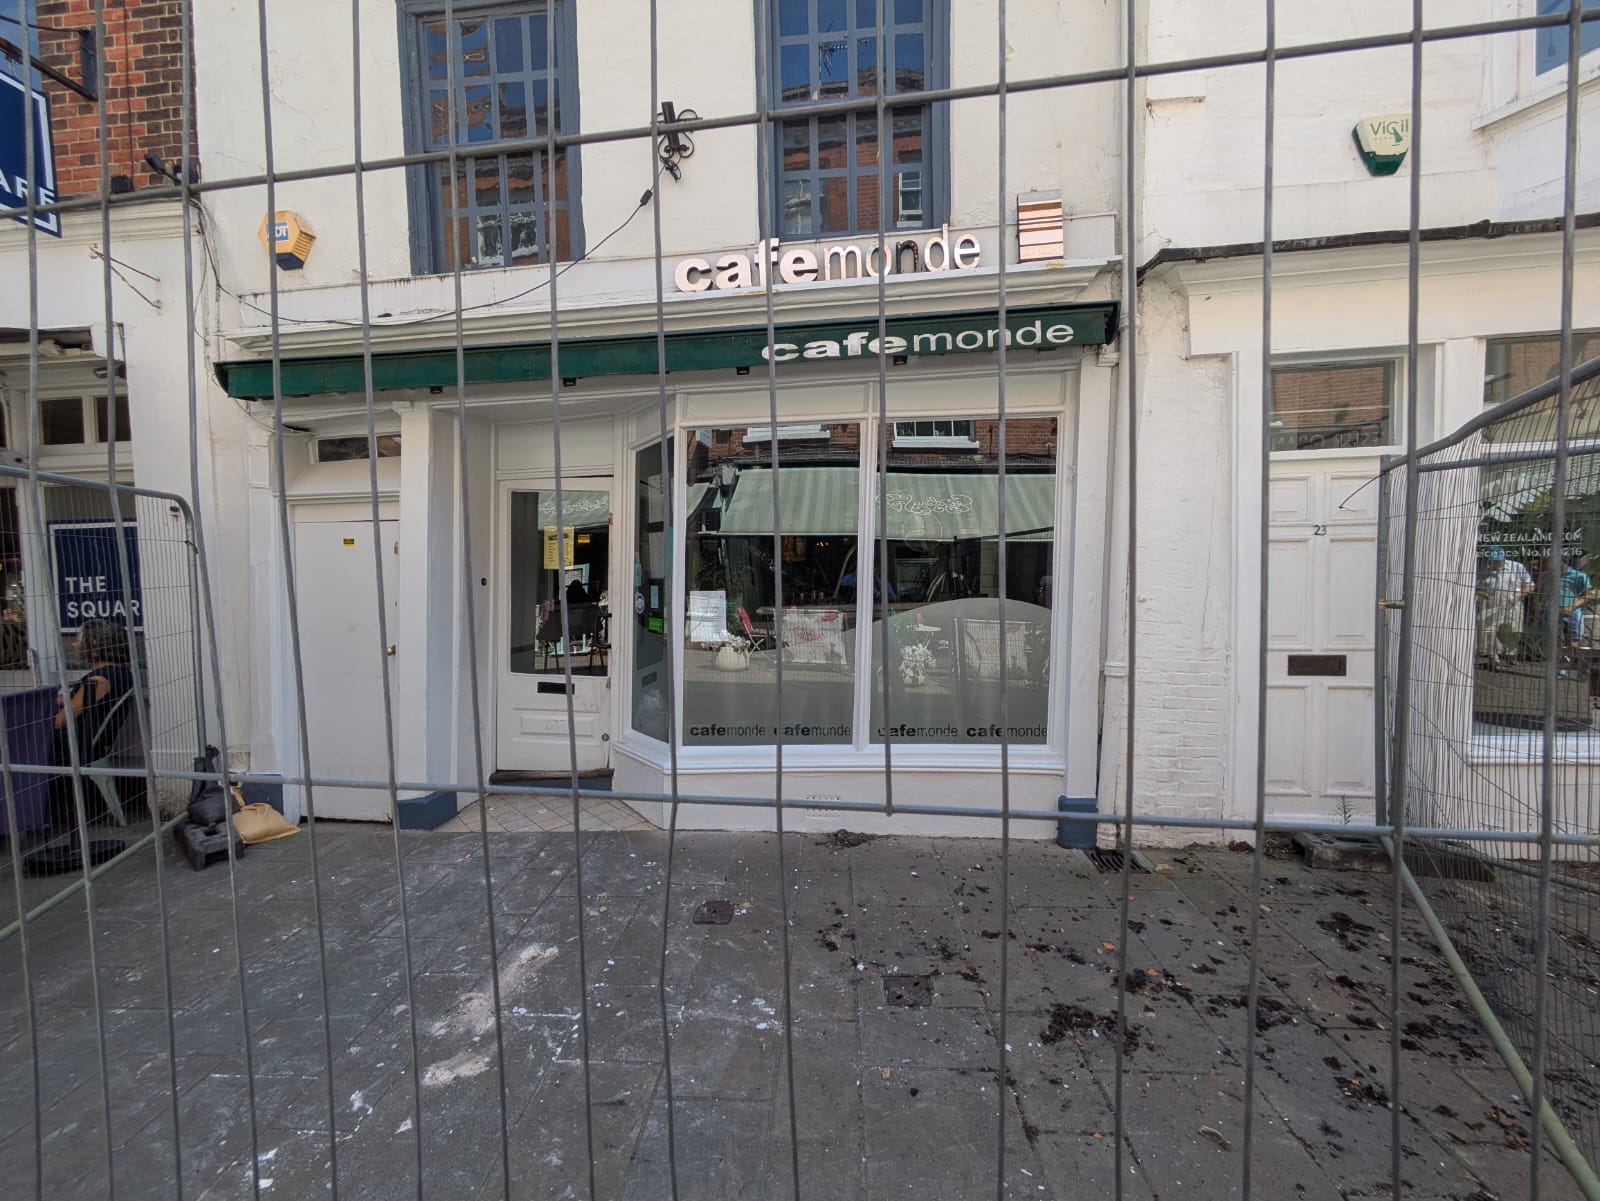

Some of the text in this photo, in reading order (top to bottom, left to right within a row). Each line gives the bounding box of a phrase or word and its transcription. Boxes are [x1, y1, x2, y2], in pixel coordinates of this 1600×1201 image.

[266, 225, 287, 240] DT
[1313, 524, 1327, 536] 23
[65, 576, 107, 593] THE
